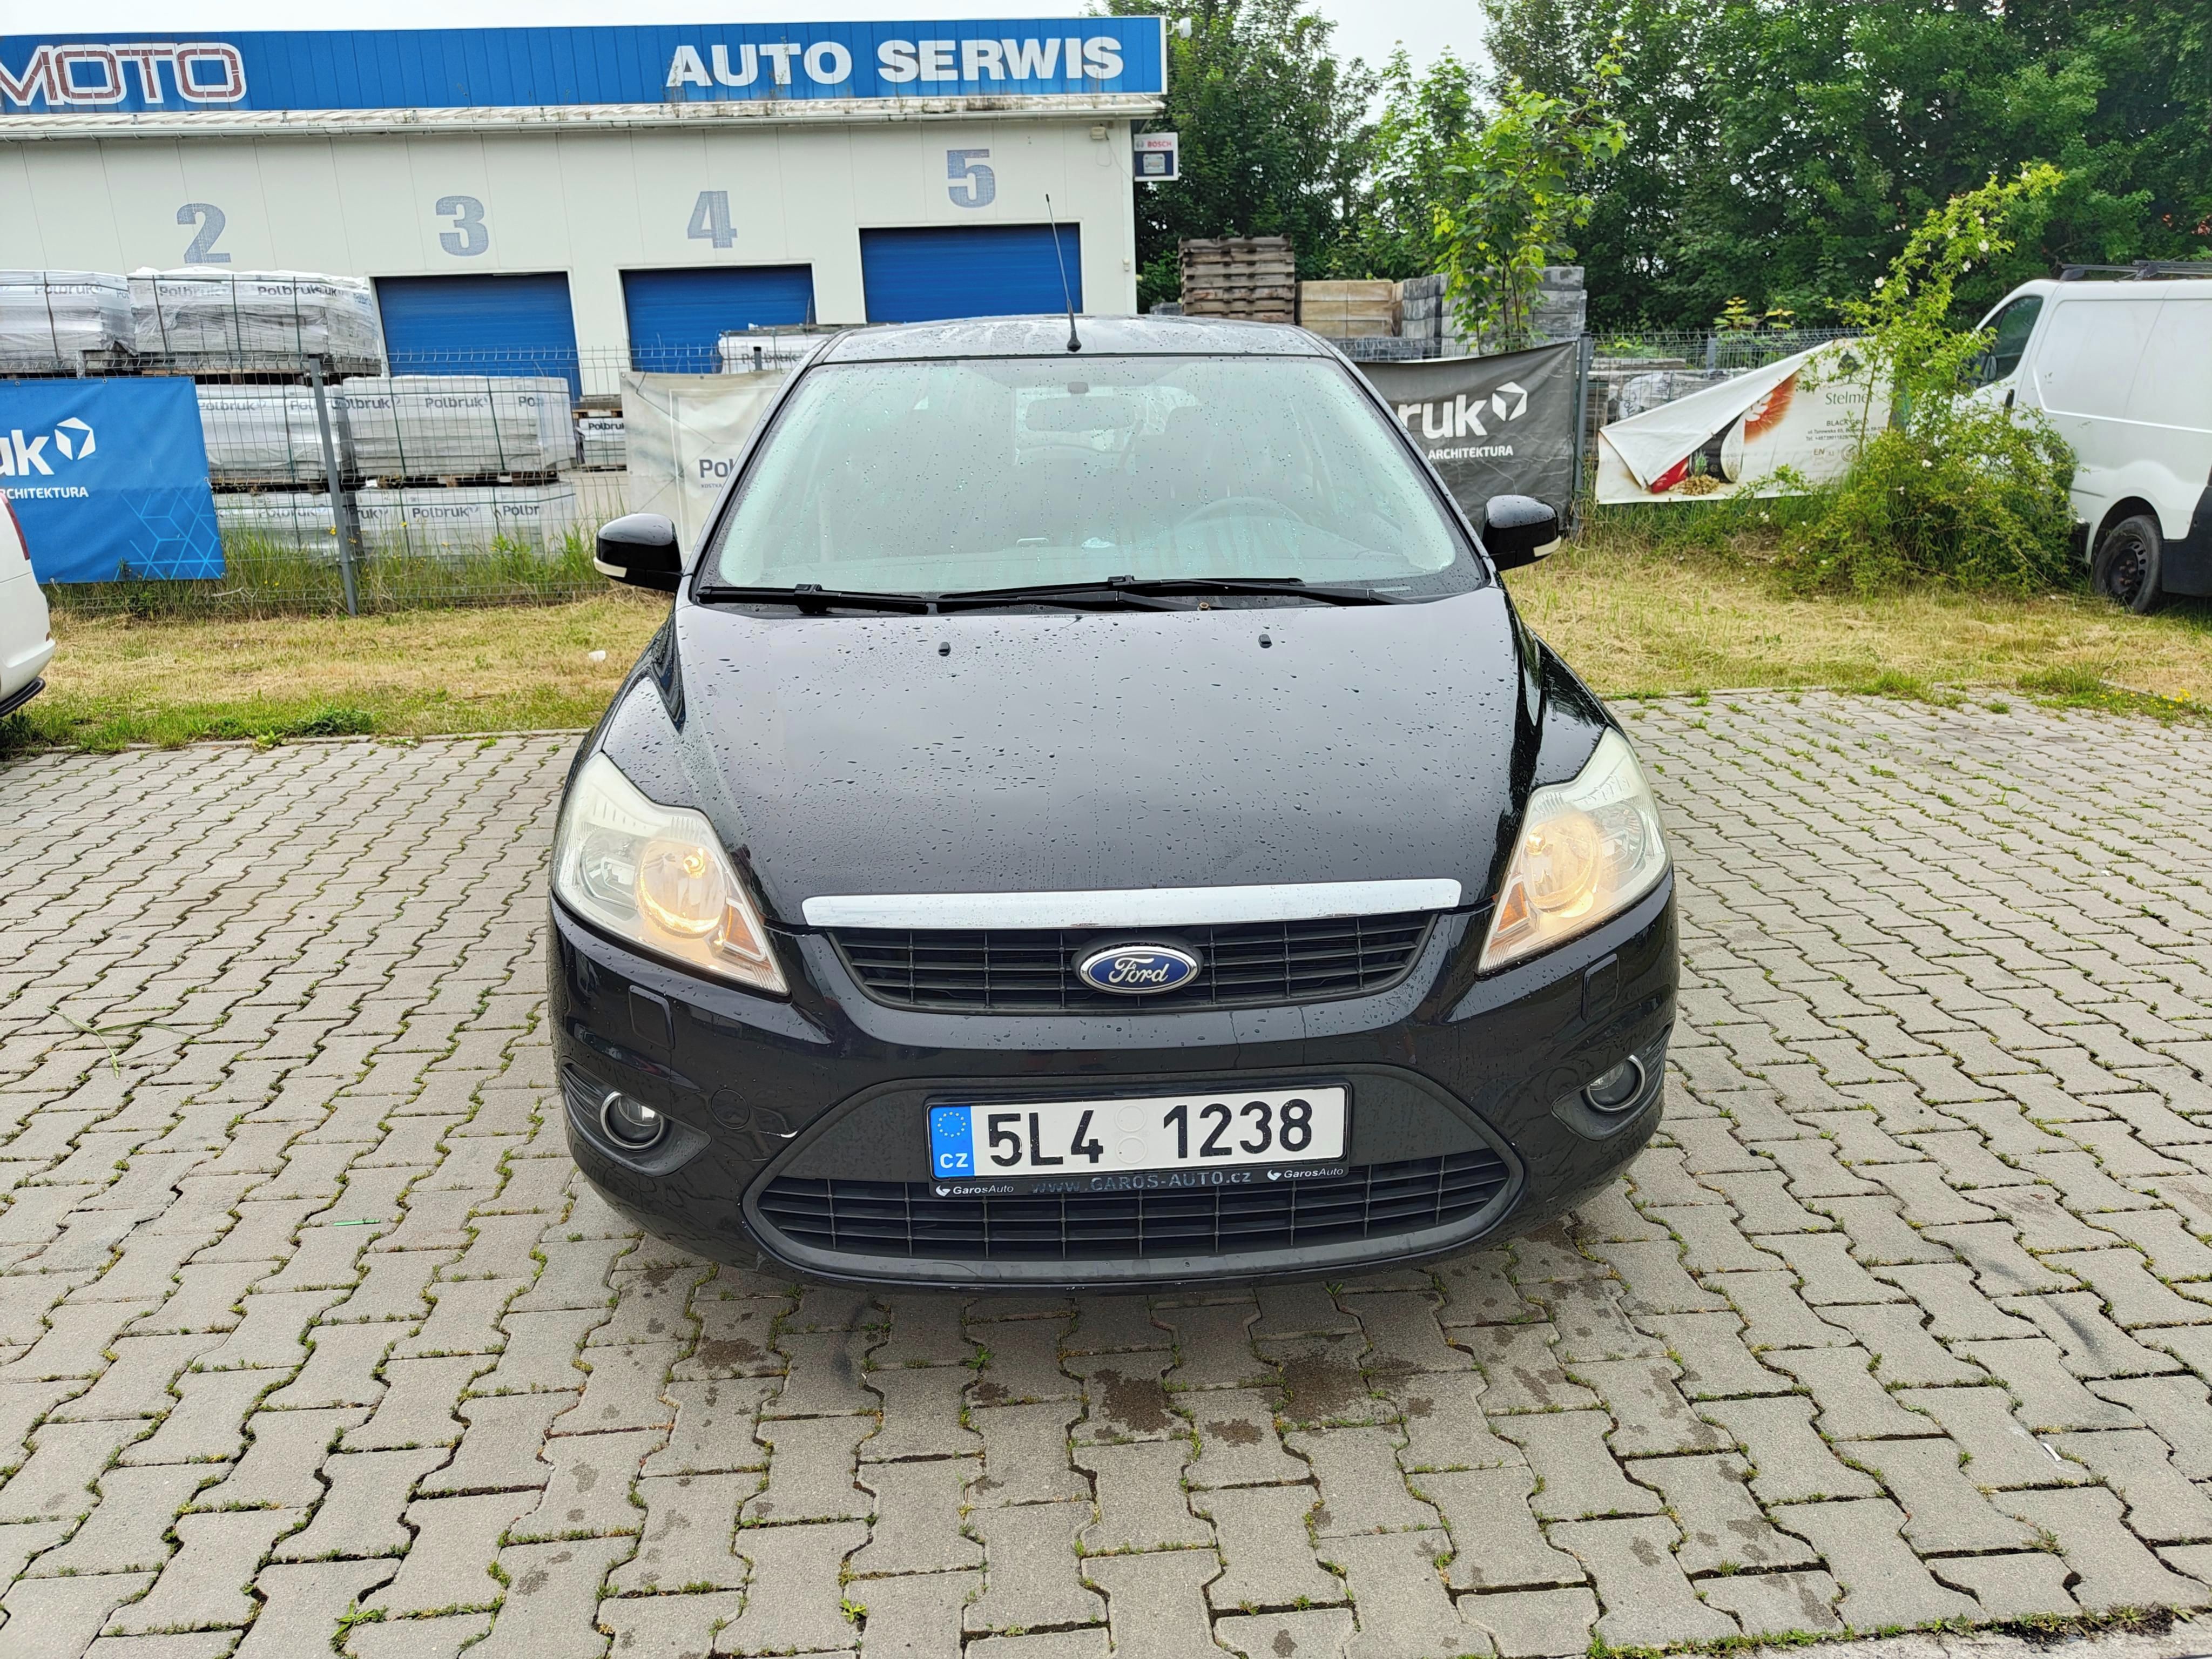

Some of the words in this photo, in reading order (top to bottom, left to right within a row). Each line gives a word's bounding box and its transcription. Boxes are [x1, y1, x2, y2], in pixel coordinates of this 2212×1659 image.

[666, 42, 853, 87] AUTO
[877, 36, 1124, 83] SERWIS
[946, 149, 996, 209] 5
[435, 195, 489, 257] 3
[687, 190, 738, 249] 4
[176, 203, 232, 264] 2
[425, 397, 484, 408] Polbruk
[1427, 445, 1514, 460] ARCHITEKTURA
[412, 507, 470, 518] Polbruk
[1108, 957, 1170, 983] Ford
[987, 1110, 1104, 1167] 5L4
[1163, 1098, 1313, 1160] 1238
[940, 1152, 969, 1169] CZ
[1284, 1168, 1344, 1178] GarosAuto
[953, 1185, 1014, 1195] GarosAuto
